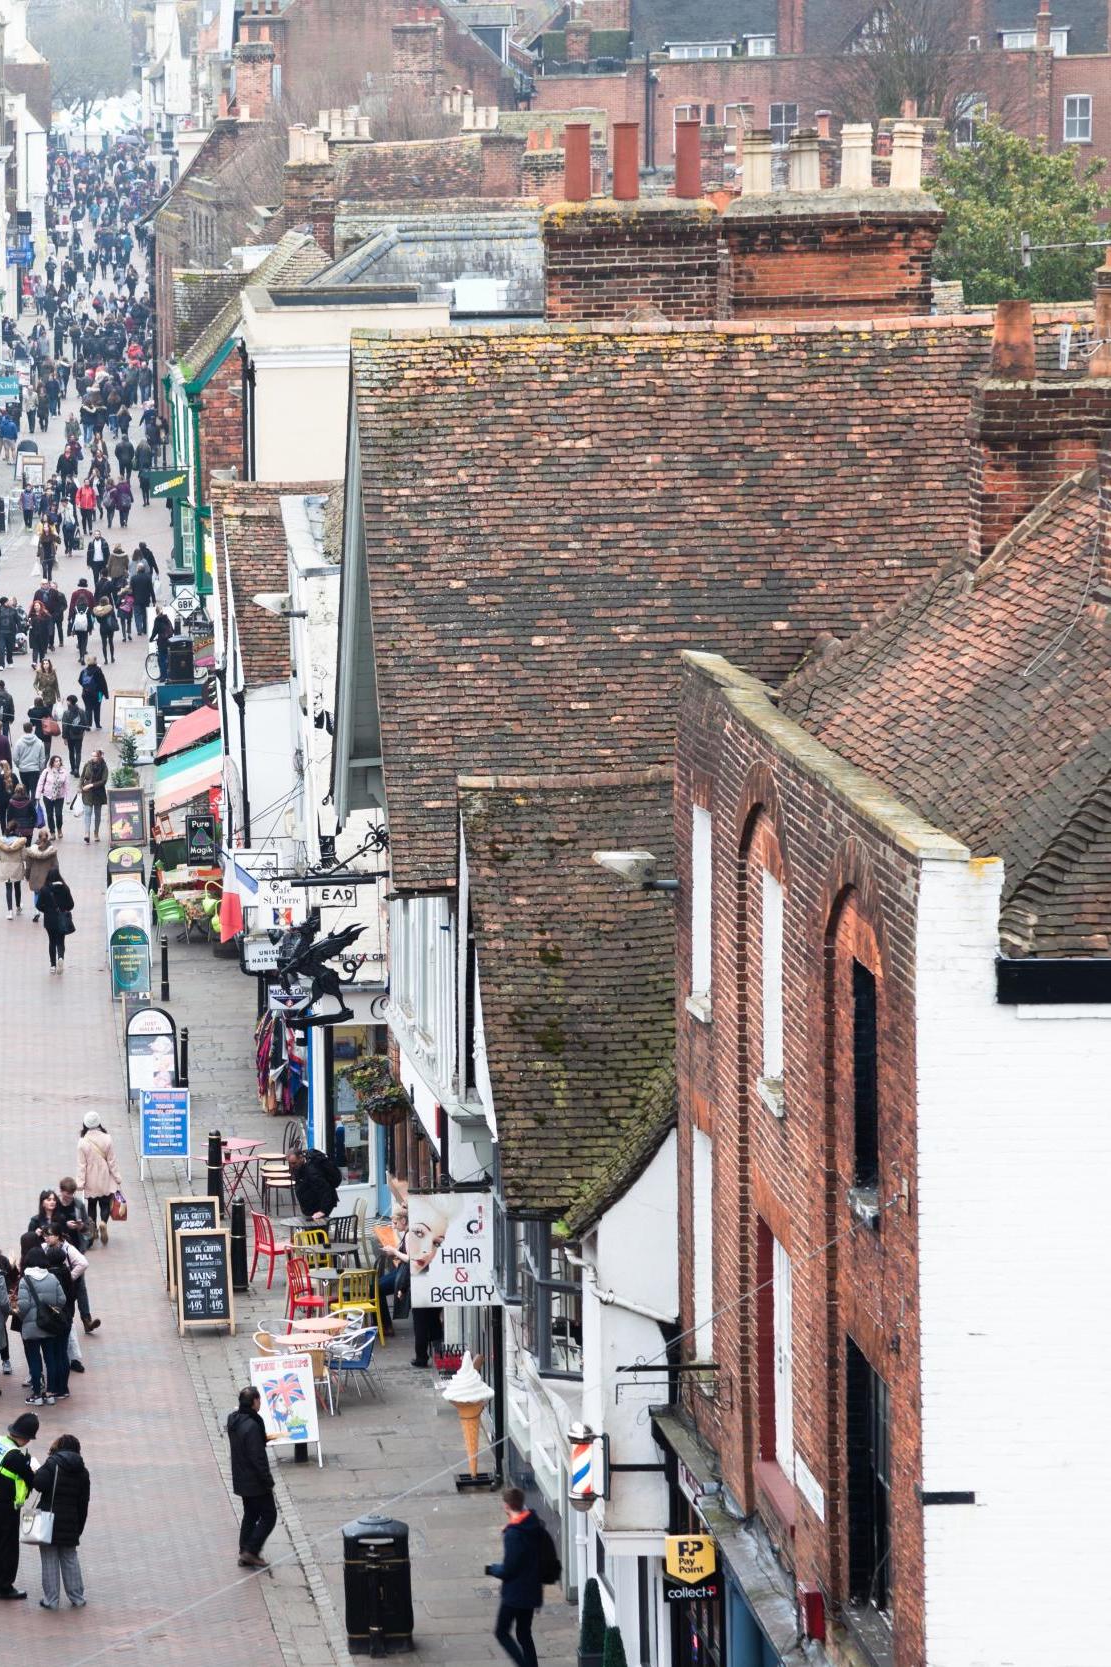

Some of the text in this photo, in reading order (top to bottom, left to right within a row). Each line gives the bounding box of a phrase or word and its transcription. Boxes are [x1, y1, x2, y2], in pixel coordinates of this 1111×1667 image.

[153, 474, 187, 495] SUBWAY
[177, 600, 194, 609] GBK
[191, 820, 210, 828] Pure
[190, 846, 213, 855] Magik
[276, 896, 302, 905] Pierre
[338, 953, 368, 961] BLACK
[185, 1246, 202, 1254] BLACK
[441, 1247, 481, 1264] HAIR
[189, 1271, 217, 1281] MAINS
[455, 1267, 469, 1283] &
[430, 1285, 495, 1303] BEAUTY
[679, 1558, 695, 1567] Pay
[679, 1566, 704, 1574] Point
